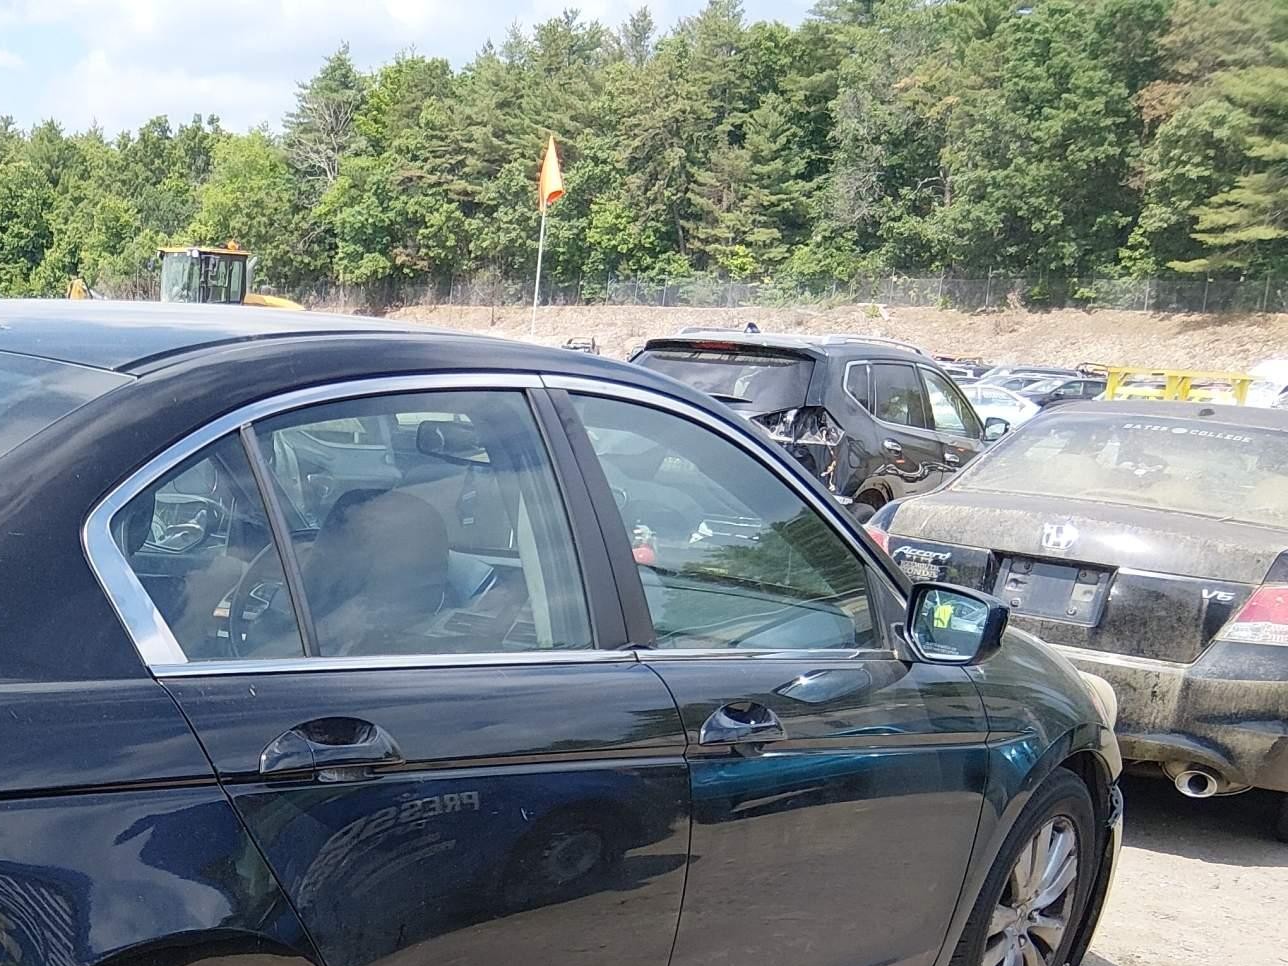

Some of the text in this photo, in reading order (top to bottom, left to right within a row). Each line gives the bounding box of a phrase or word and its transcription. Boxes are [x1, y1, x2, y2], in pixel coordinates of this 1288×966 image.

[1189, 429, 1254, 443] COLLEGE
[892, 545, 952, 561] Accord
[1201, 589, 1236, 601] V6
